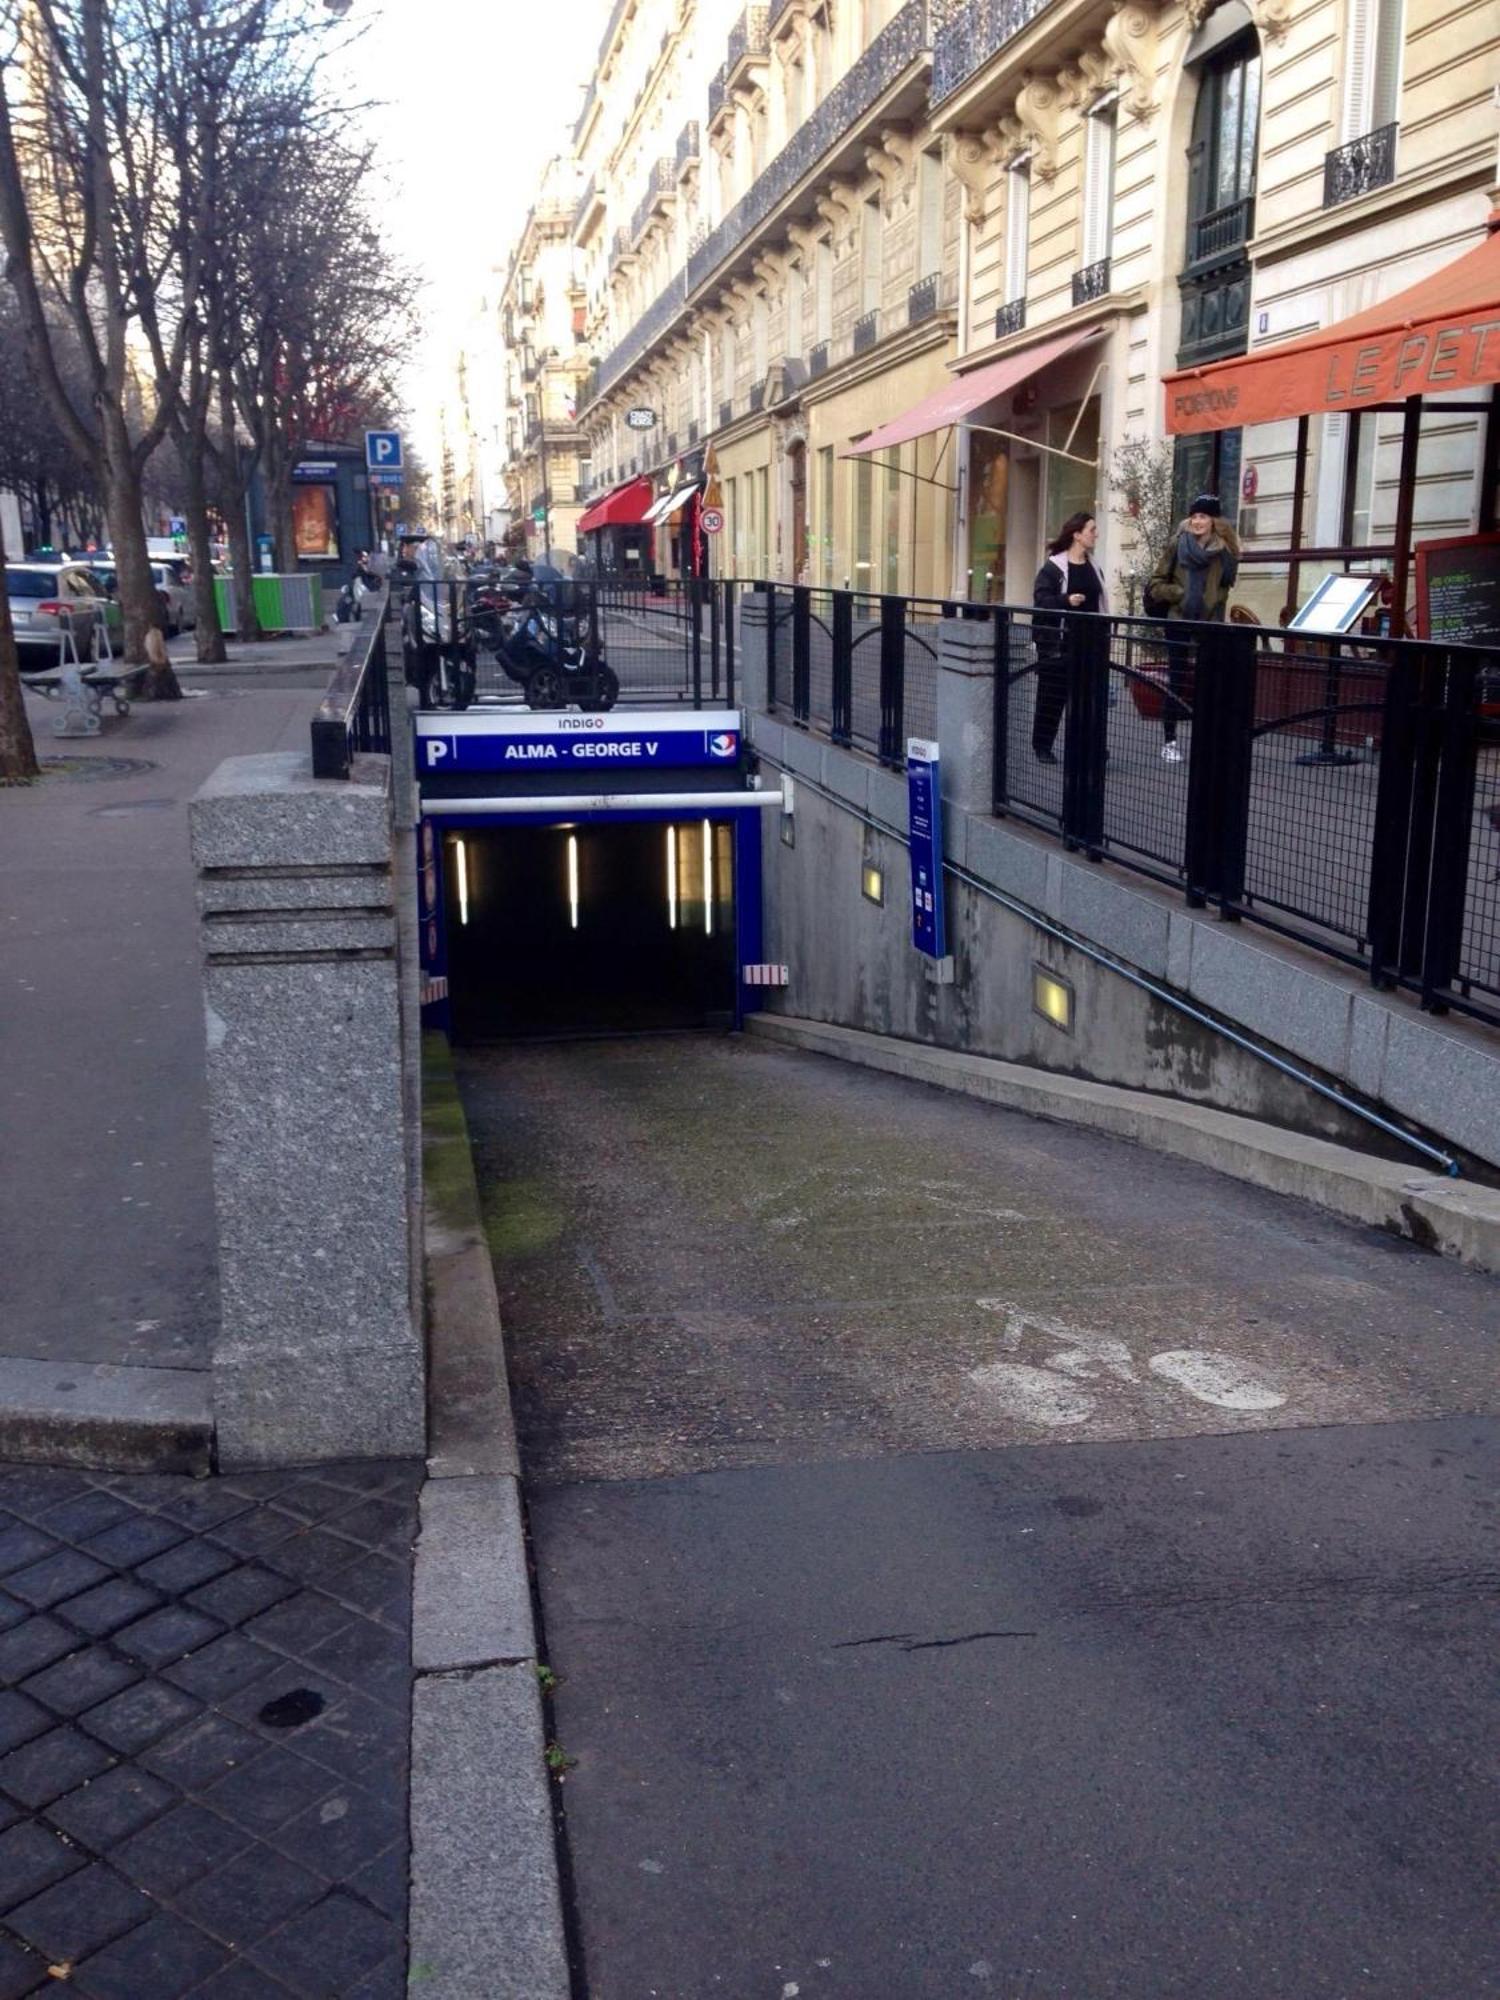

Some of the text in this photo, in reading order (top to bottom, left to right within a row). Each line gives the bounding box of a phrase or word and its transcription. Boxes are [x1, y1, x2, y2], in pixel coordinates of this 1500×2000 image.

[1326, 320, 1500, 401] LE PET
[376, 439, 393, 461] P
[706, 516, 720, 527] 30
[558, 718, 604, 729] INDIGO
[426, 740, 448, 766] P
[505, 744, 557, 758] ALMA
[572, 742, 641, 758] GEORGE
[646, 741, 658, 756] V
